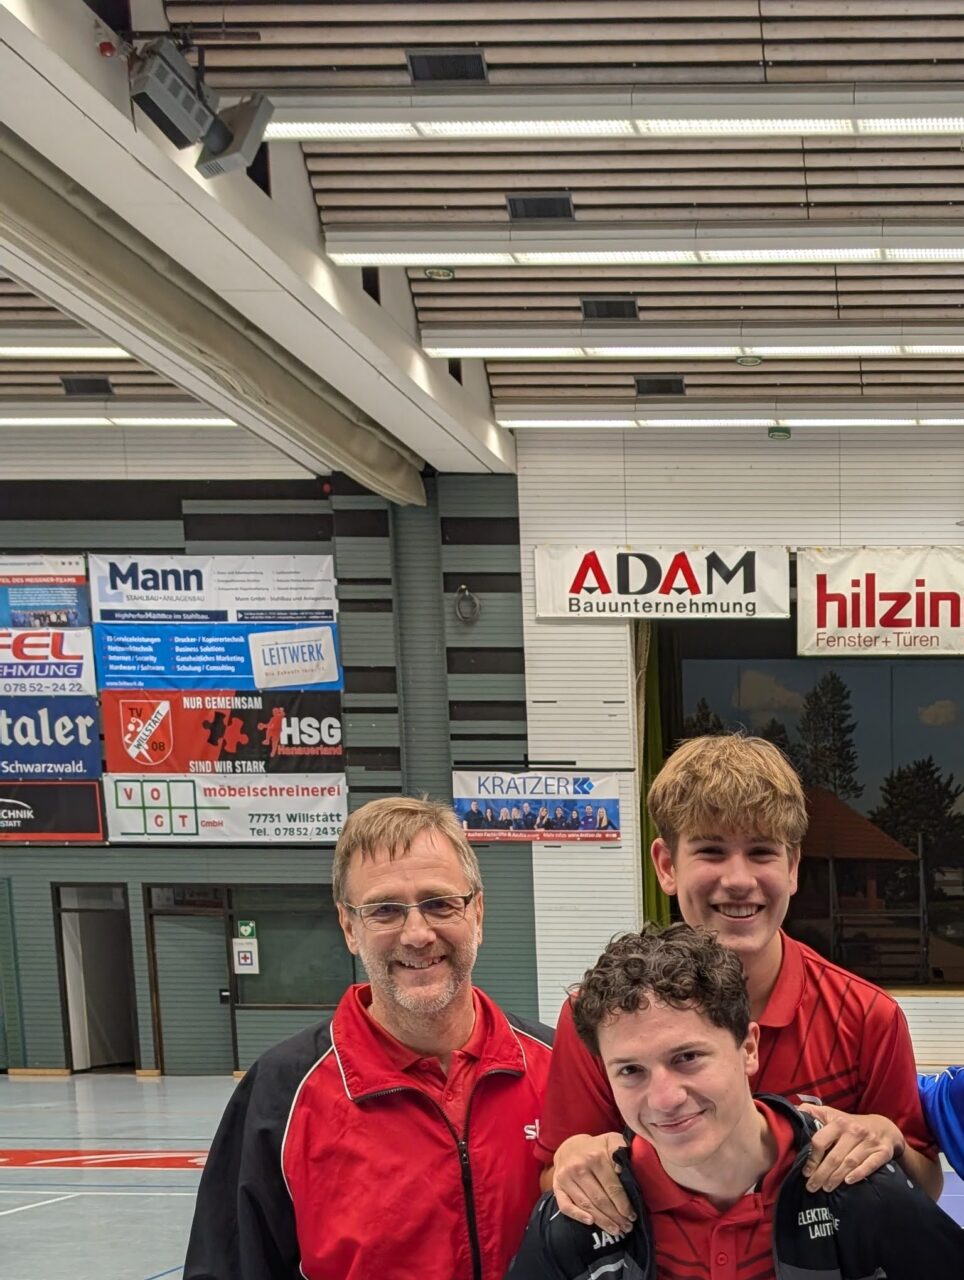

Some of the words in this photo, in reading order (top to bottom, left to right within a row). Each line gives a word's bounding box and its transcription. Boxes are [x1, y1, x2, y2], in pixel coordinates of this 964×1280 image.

[109, 562, 203, 591] Mann
[568, 550, 756, 595] ADAM
[568, 597, 756, 616] Bauunternehmung
[816, 630, 940, 648] Fenster+Türen
[261, 643, 325, 666] LEITWERK
[183, 697, 203, 709] NUR
[205, 696, 263, 709] GEMEINSAM
[128, 708, 143, 718] TV
[0, 707, 94, 746] taler
[280, 717, 342, 745] HSG
[1, 760, 87, 773] Schwarzwald.
[189, 761, 212, 773] SIND
[214, 761, 233, 773] WIR
[235, 761, 266, 773] STARK
[203, 785, 341, 797] möbelschreinerei
[477, 776, 570, 795] KRATZER
[0, 809, 35, 819] CHNIK
[248, 813, 282, 823] 77731
[286, 812, 342, 823] Willstätt
[250, 827, 270, 836] Tel.
